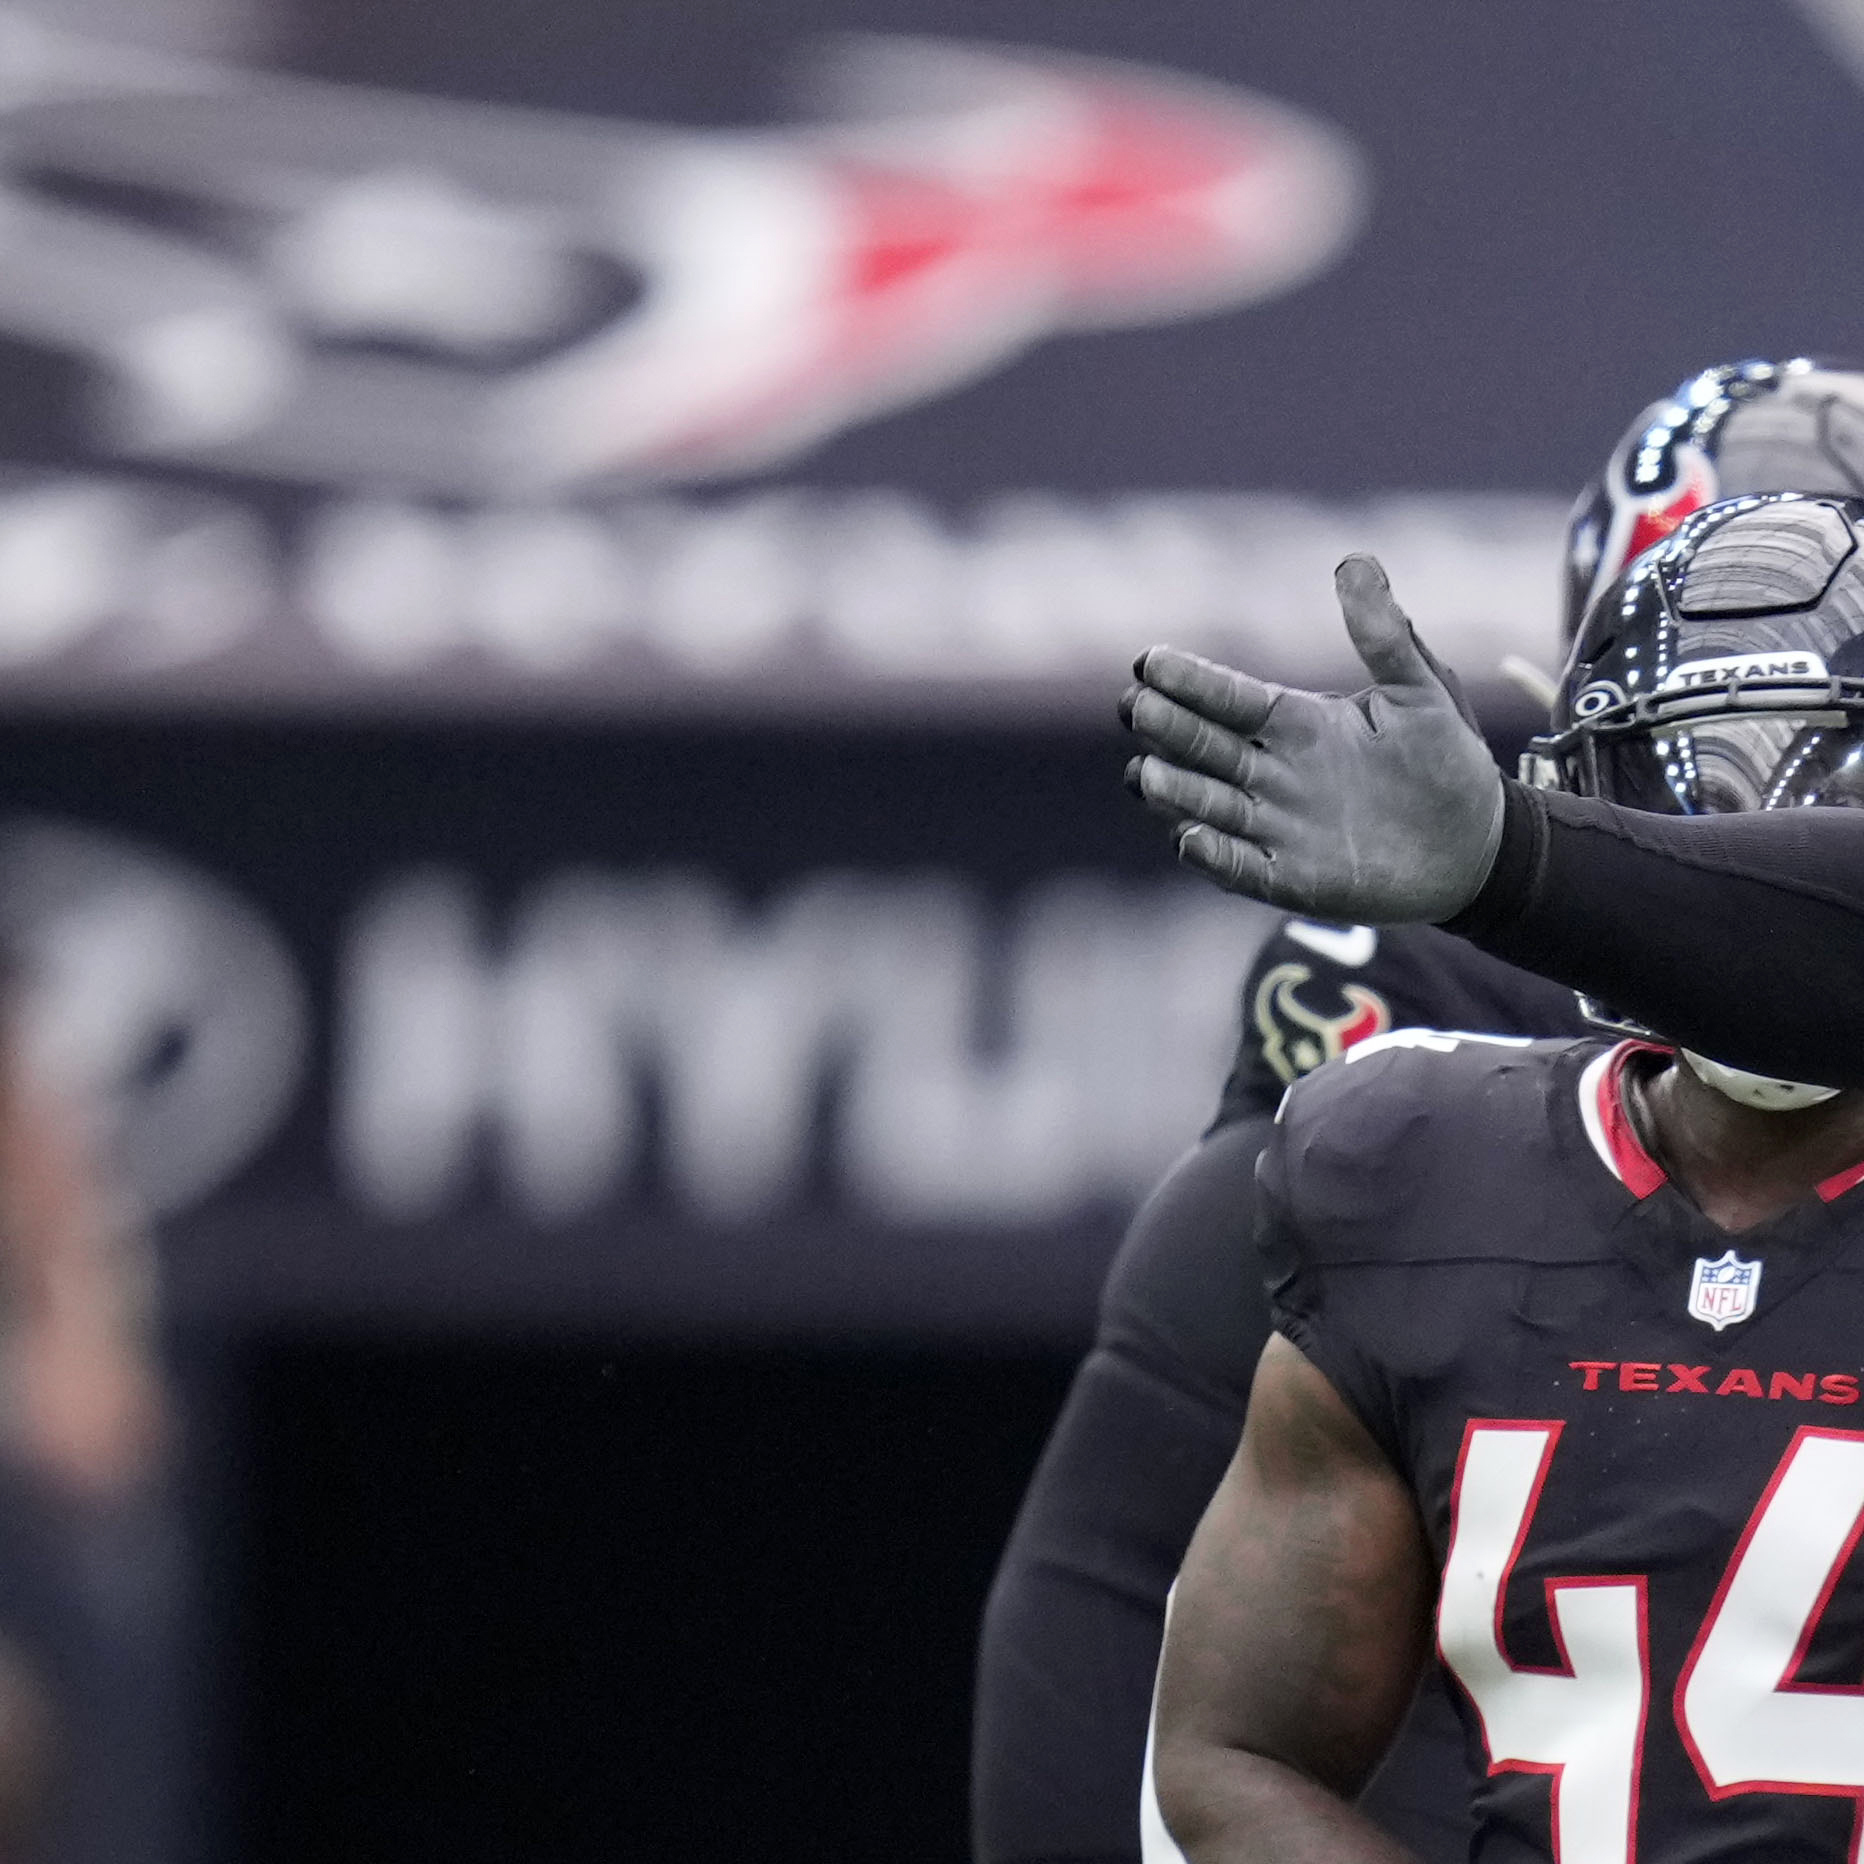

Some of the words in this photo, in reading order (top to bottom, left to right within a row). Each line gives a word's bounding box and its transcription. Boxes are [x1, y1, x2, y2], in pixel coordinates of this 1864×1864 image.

[1678, 660, 1810, 687] TEXANS
[1701, 1286, 1743, 1315] NFL
[1568, 1360, 1861, 1406] TEXANS
